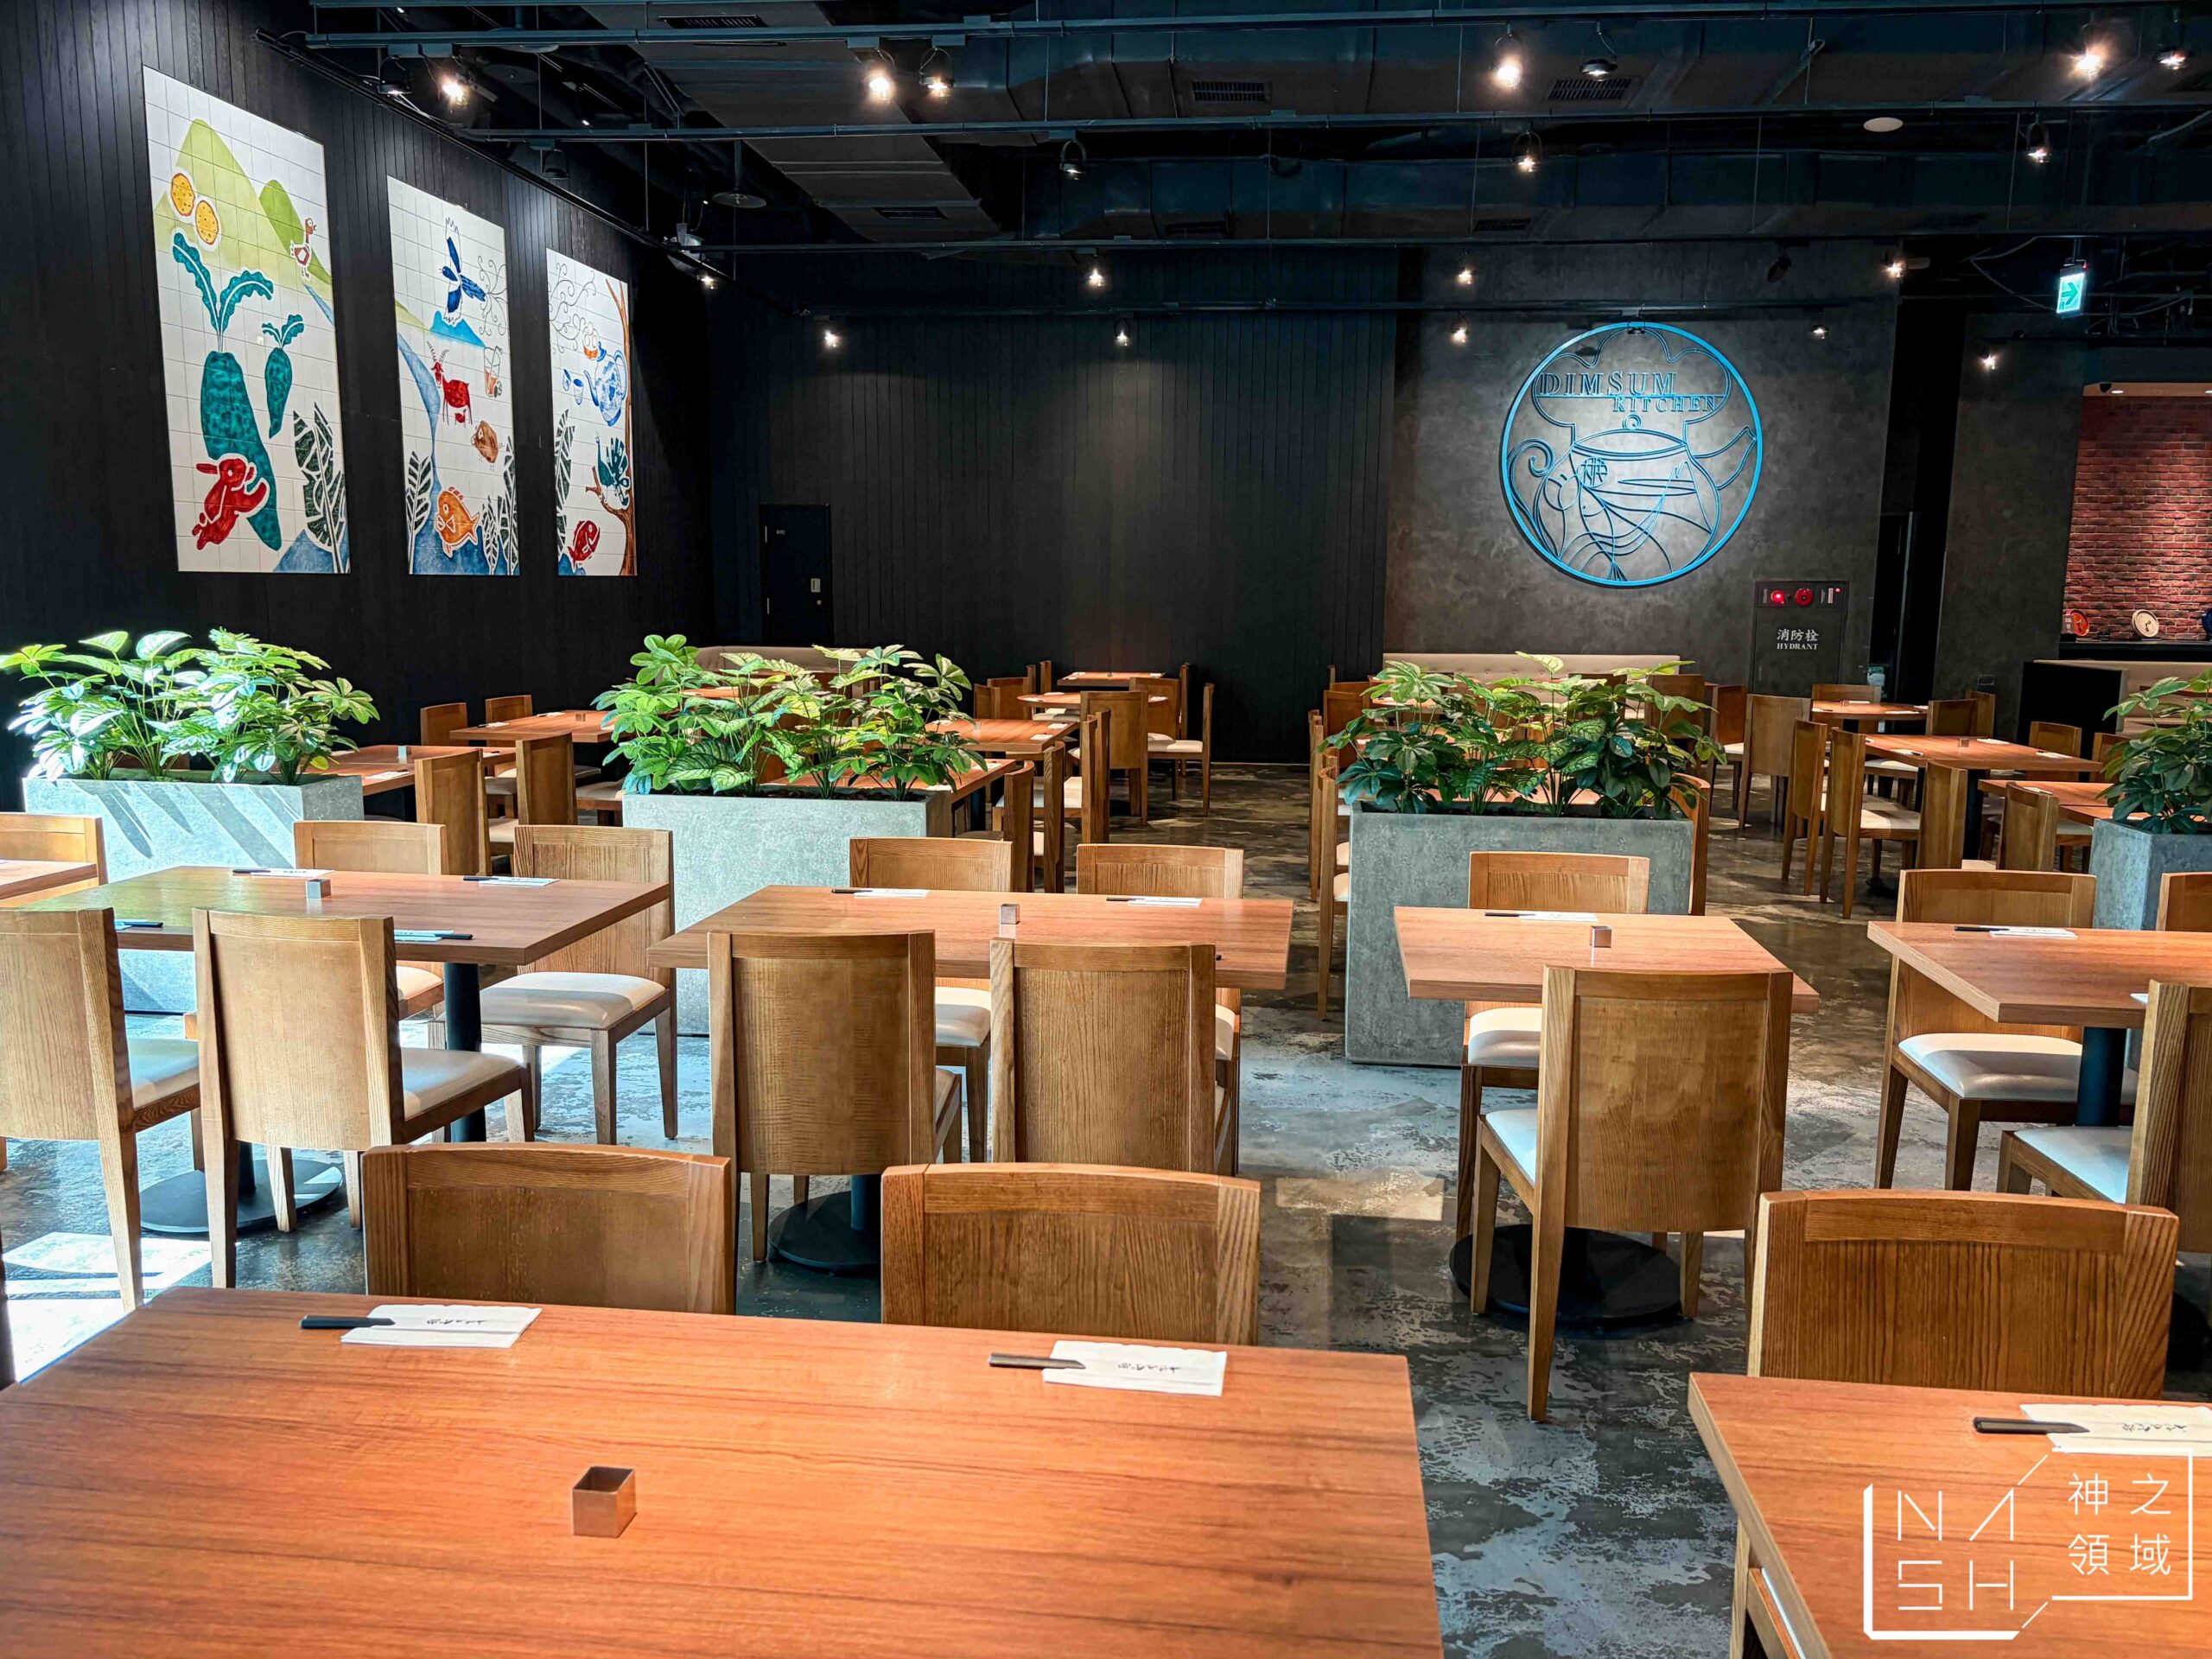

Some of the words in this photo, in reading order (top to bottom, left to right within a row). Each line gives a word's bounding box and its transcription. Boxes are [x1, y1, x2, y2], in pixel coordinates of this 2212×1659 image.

[1539, 370, 1678, 396] DIMSUM
[1611, 396, 1716, 413] KITCHEN
[1777, 628, 1820, 642] 消防栓
[1777, 642, 1819, 651] HYDRANT
